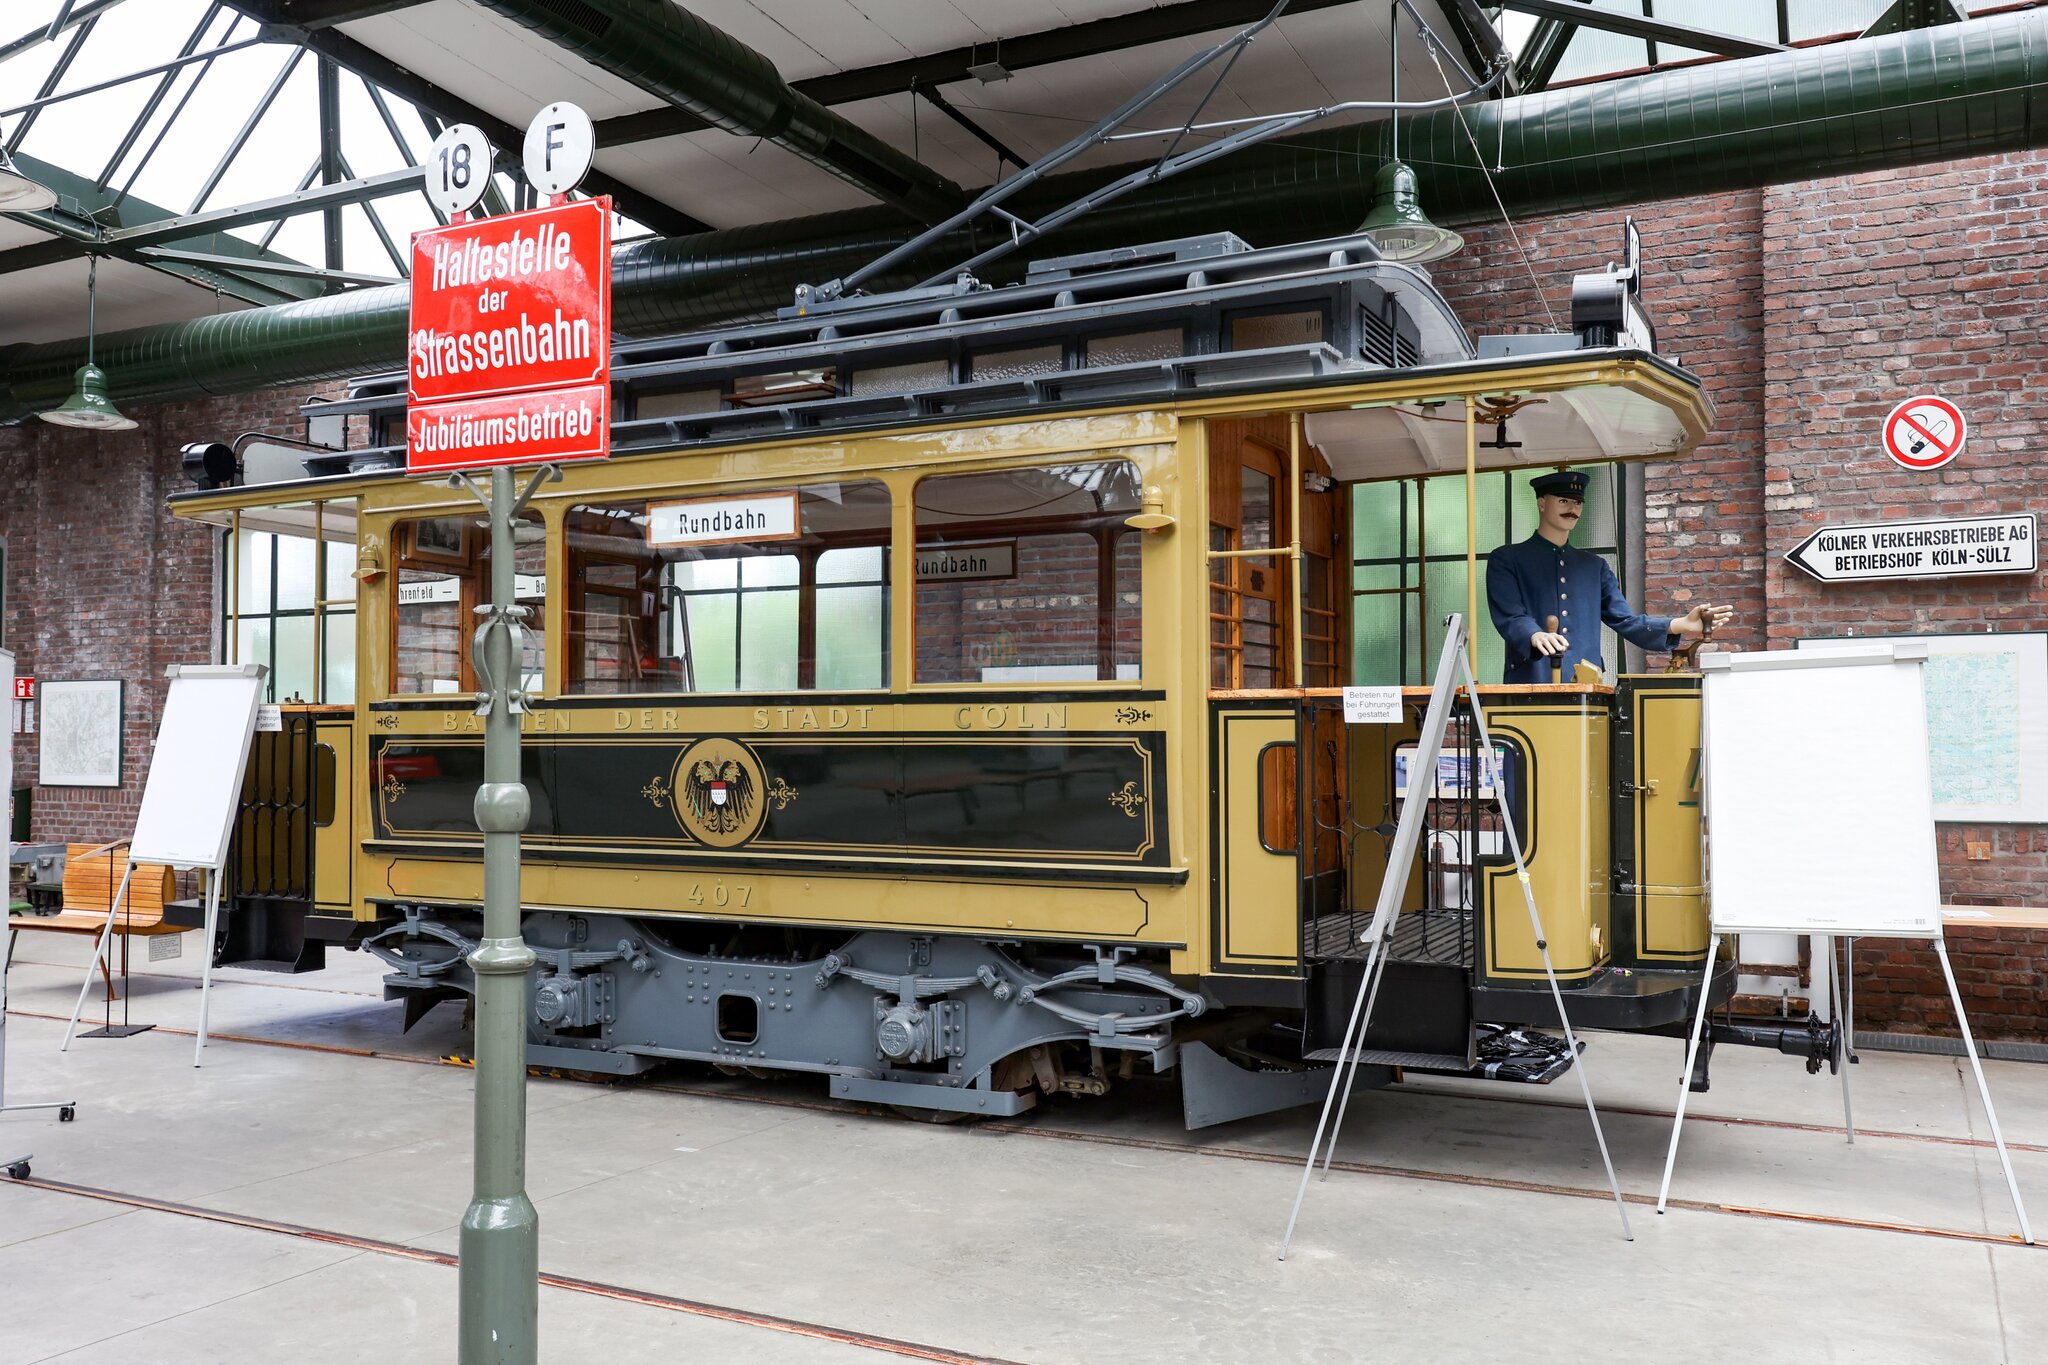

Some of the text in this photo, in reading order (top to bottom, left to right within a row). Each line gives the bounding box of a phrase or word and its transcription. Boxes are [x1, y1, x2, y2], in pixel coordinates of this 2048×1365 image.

[545, 123, 566, 172] F
[438, 143, 471, 192] 18
[432, 222, 571, 292] Haltestelle
[478, 288, 508, 313] der
[415, 308, 590, 380] Strassenbahn
[414, 400, 592, 453] Jubiläumsbetrieb
[680, 507, 767, 535] Rundbahn
[1818, 524, 2028, 552] KÖLNER VERKEHRSBETRIEBE AG
[1835, 546, 2012, 571] BETRIEBSHOF KÖLN-SÜLZ
[399, 585, 433, 601] hrenfeld
[1345, 701, 1400, 709] bei Führungen
[1349, 691, 1396, 699] Betreten nur
[443, 702, 1068, 733] BAEN DER STADT CÖLN
[1357, 711, 1390, 719] gestattet
[687, 884, 753, 908] 407
